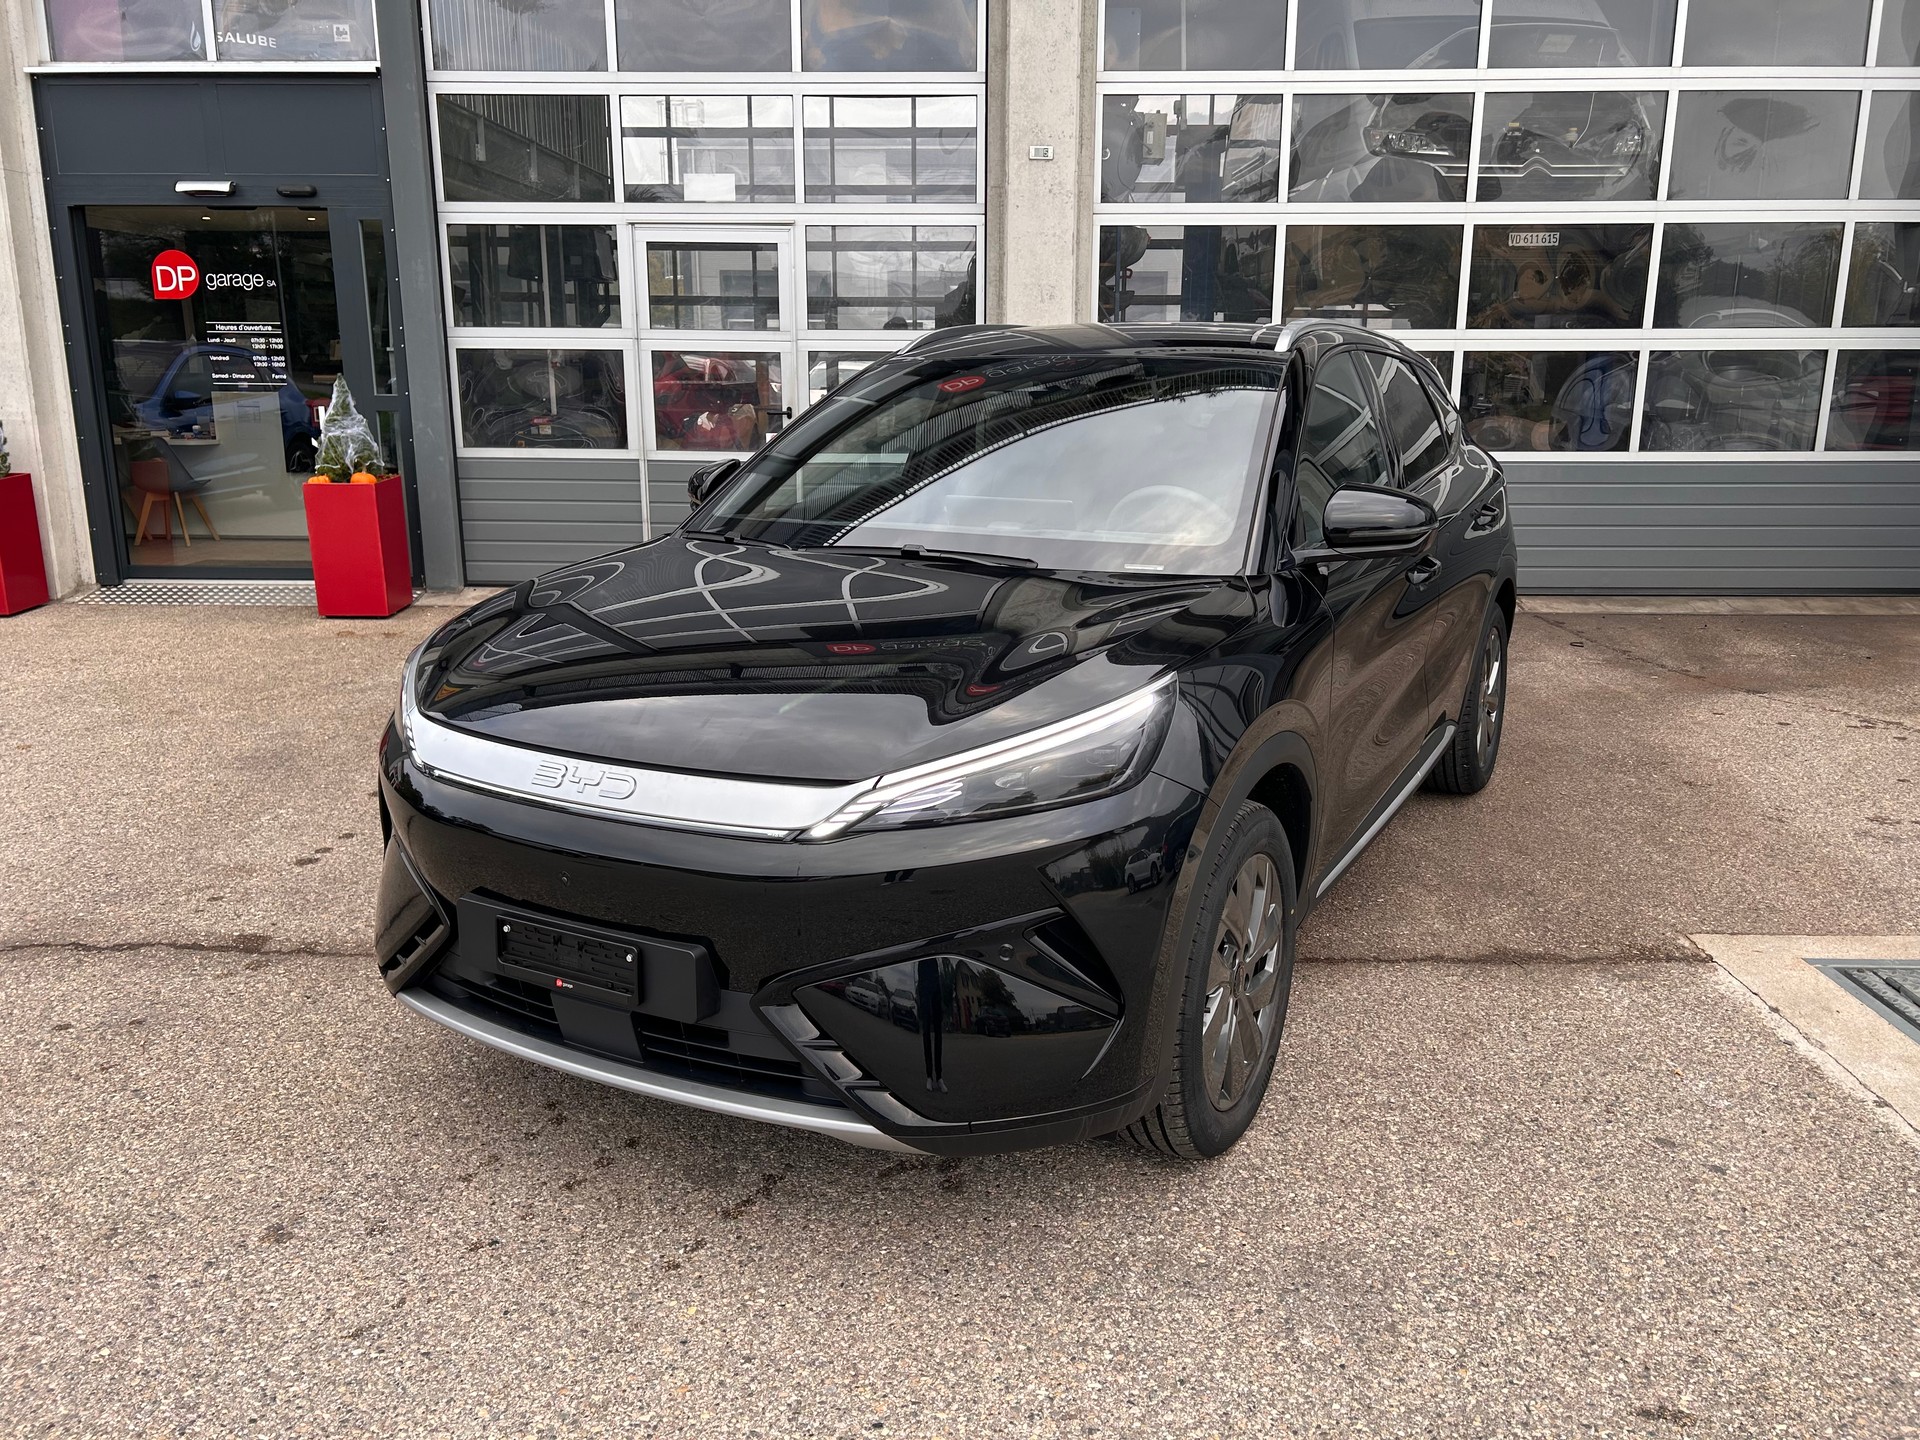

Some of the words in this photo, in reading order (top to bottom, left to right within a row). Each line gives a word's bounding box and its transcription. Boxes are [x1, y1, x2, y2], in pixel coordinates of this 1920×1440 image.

[1510, 234, 1521, 245] VD
[1523, 233, 1539, 244] 611
[1541, 233, 1558, 244] 615
[155, 265, 197, 292] DP
[205, 273, 264, 291] garage
[266, 279, 277, 288] SA
[531, 760, 638, 800] BYD
